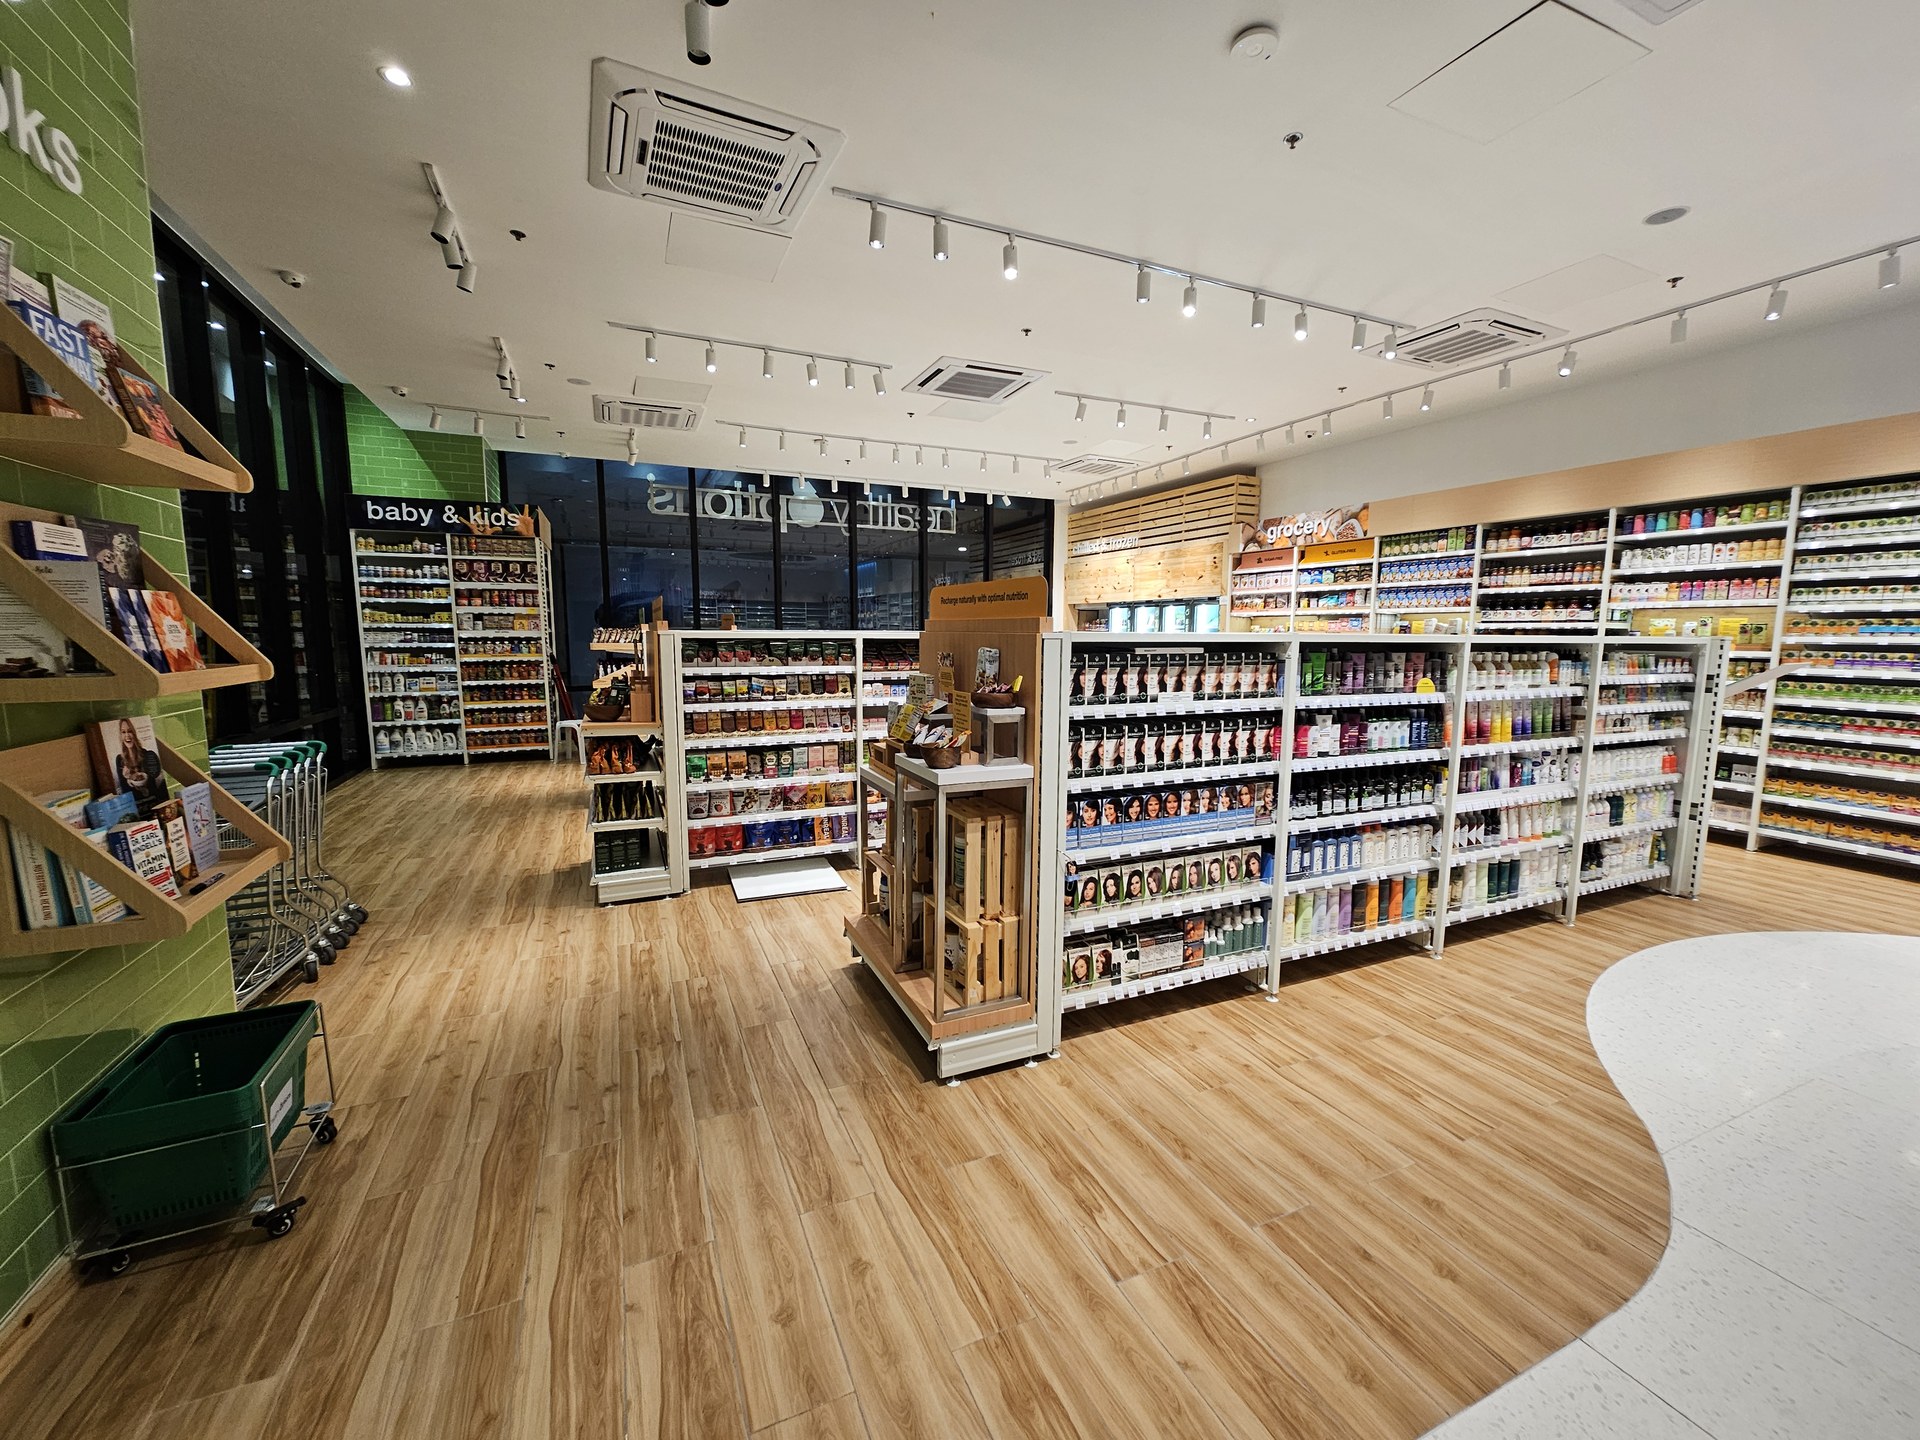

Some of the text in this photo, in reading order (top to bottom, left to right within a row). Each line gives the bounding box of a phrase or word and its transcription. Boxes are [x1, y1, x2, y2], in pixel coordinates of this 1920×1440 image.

[0, 66, 83, 195] ks
[29, 310, 85, 357] FAST
[366, 500, 521, 528] baby & kids
[1266, 516, 1332, 545] grocery
[940, 591, 1029, 606] Recharge naturally with optimal nutrition
[132, 839, 163, 854] MINDELL'S
[141, 832, 160, 843] EARL
[136, 852, 167, 870] VITAMIN
[142, 862, 164, 877] BIBLE
[34, 864, 48, 898] NUTRITIONAL
[39, 898, 52, 921] HEALING
